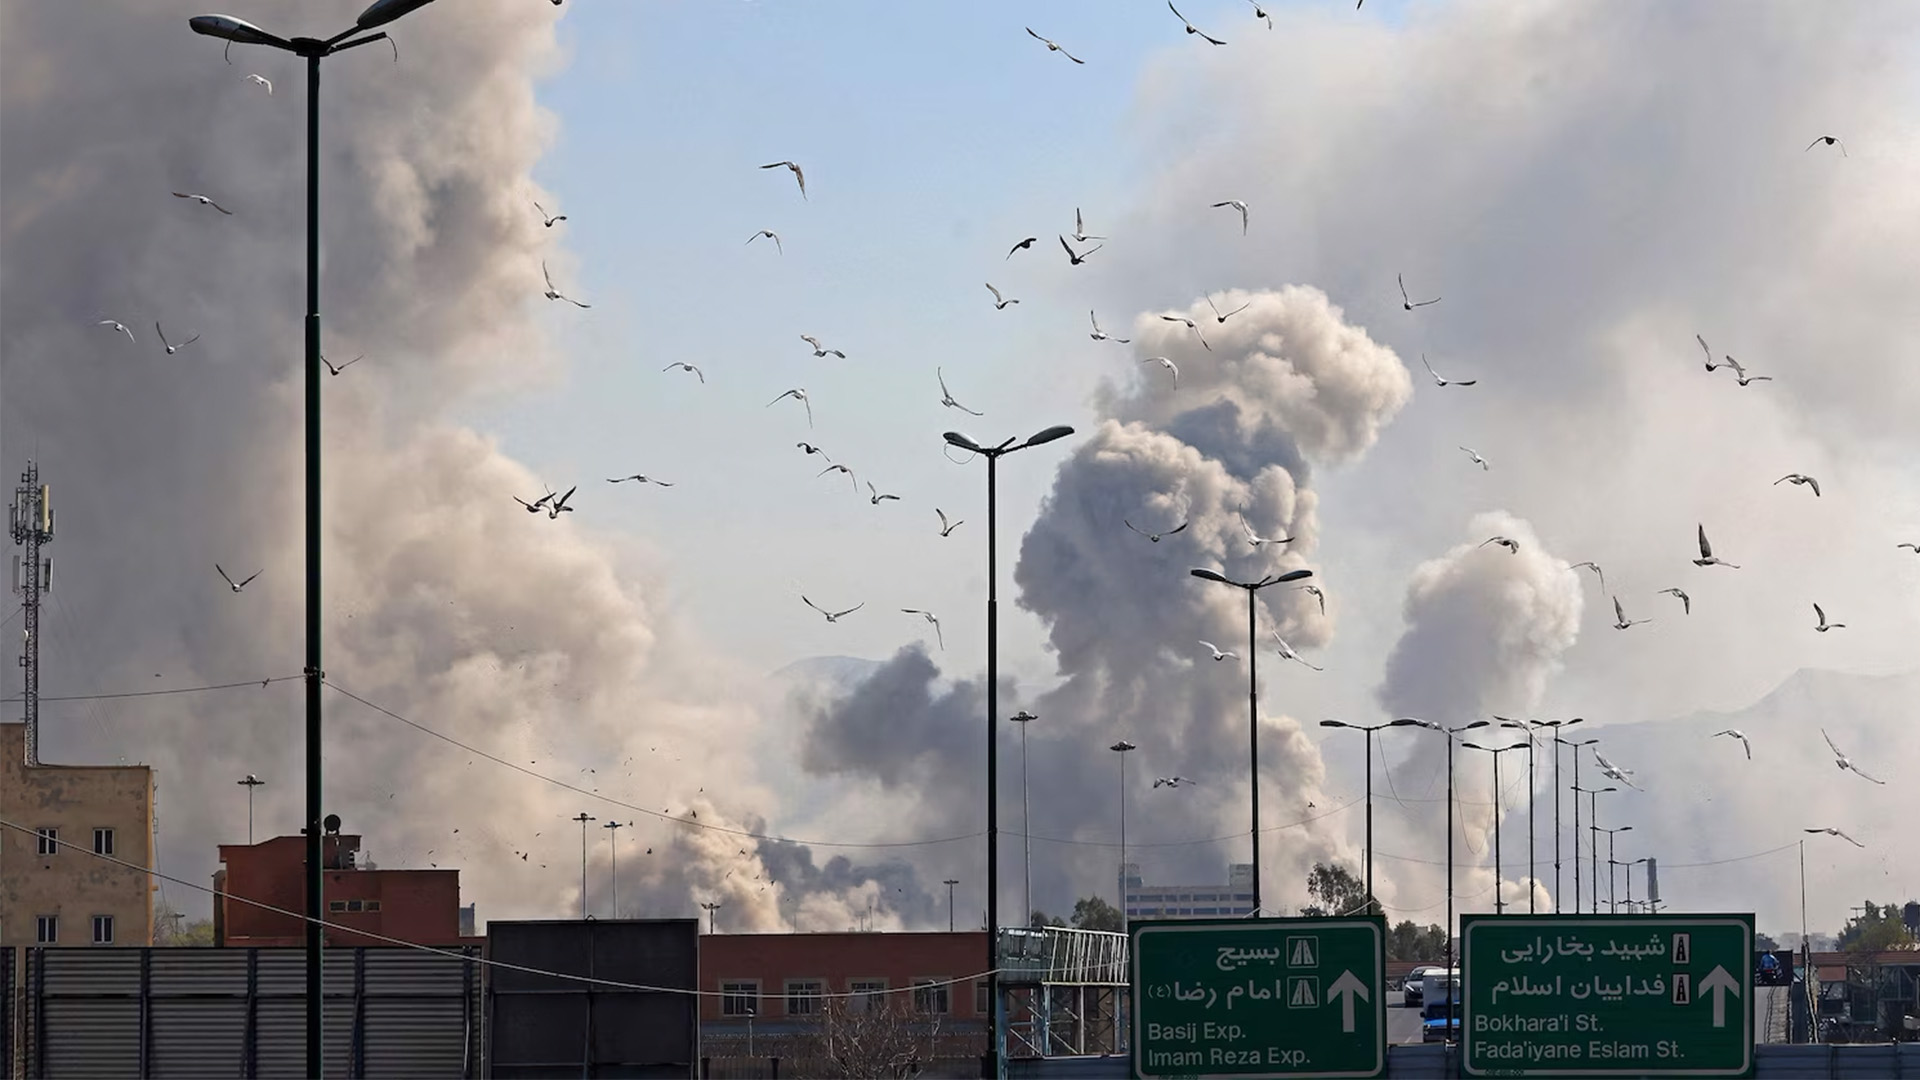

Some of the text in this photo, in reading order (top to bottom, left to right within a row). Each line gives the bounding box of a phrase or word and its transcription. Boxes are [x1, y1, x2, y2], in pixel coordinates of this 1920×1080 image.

[1216, 947, 1280, 971] بسیج
[1501, 934, 1665, 964] شهید بخارایی
[1174, 981, 1217, 1009] رضا
[1227, 979, 1281, 1010] امام
[1492, 974, 1665, 1005] فداییان اسلام
[1148, 1022, 1246, 1043] Basij Exp.
[1475, 1014, 1603, 1032] Bokhara'i St.
[1149, 1047, 1310, 1067] Imam Reza Exp.
[1475, 1040, 1685, 1062] Fada'iyane Eslam St.
